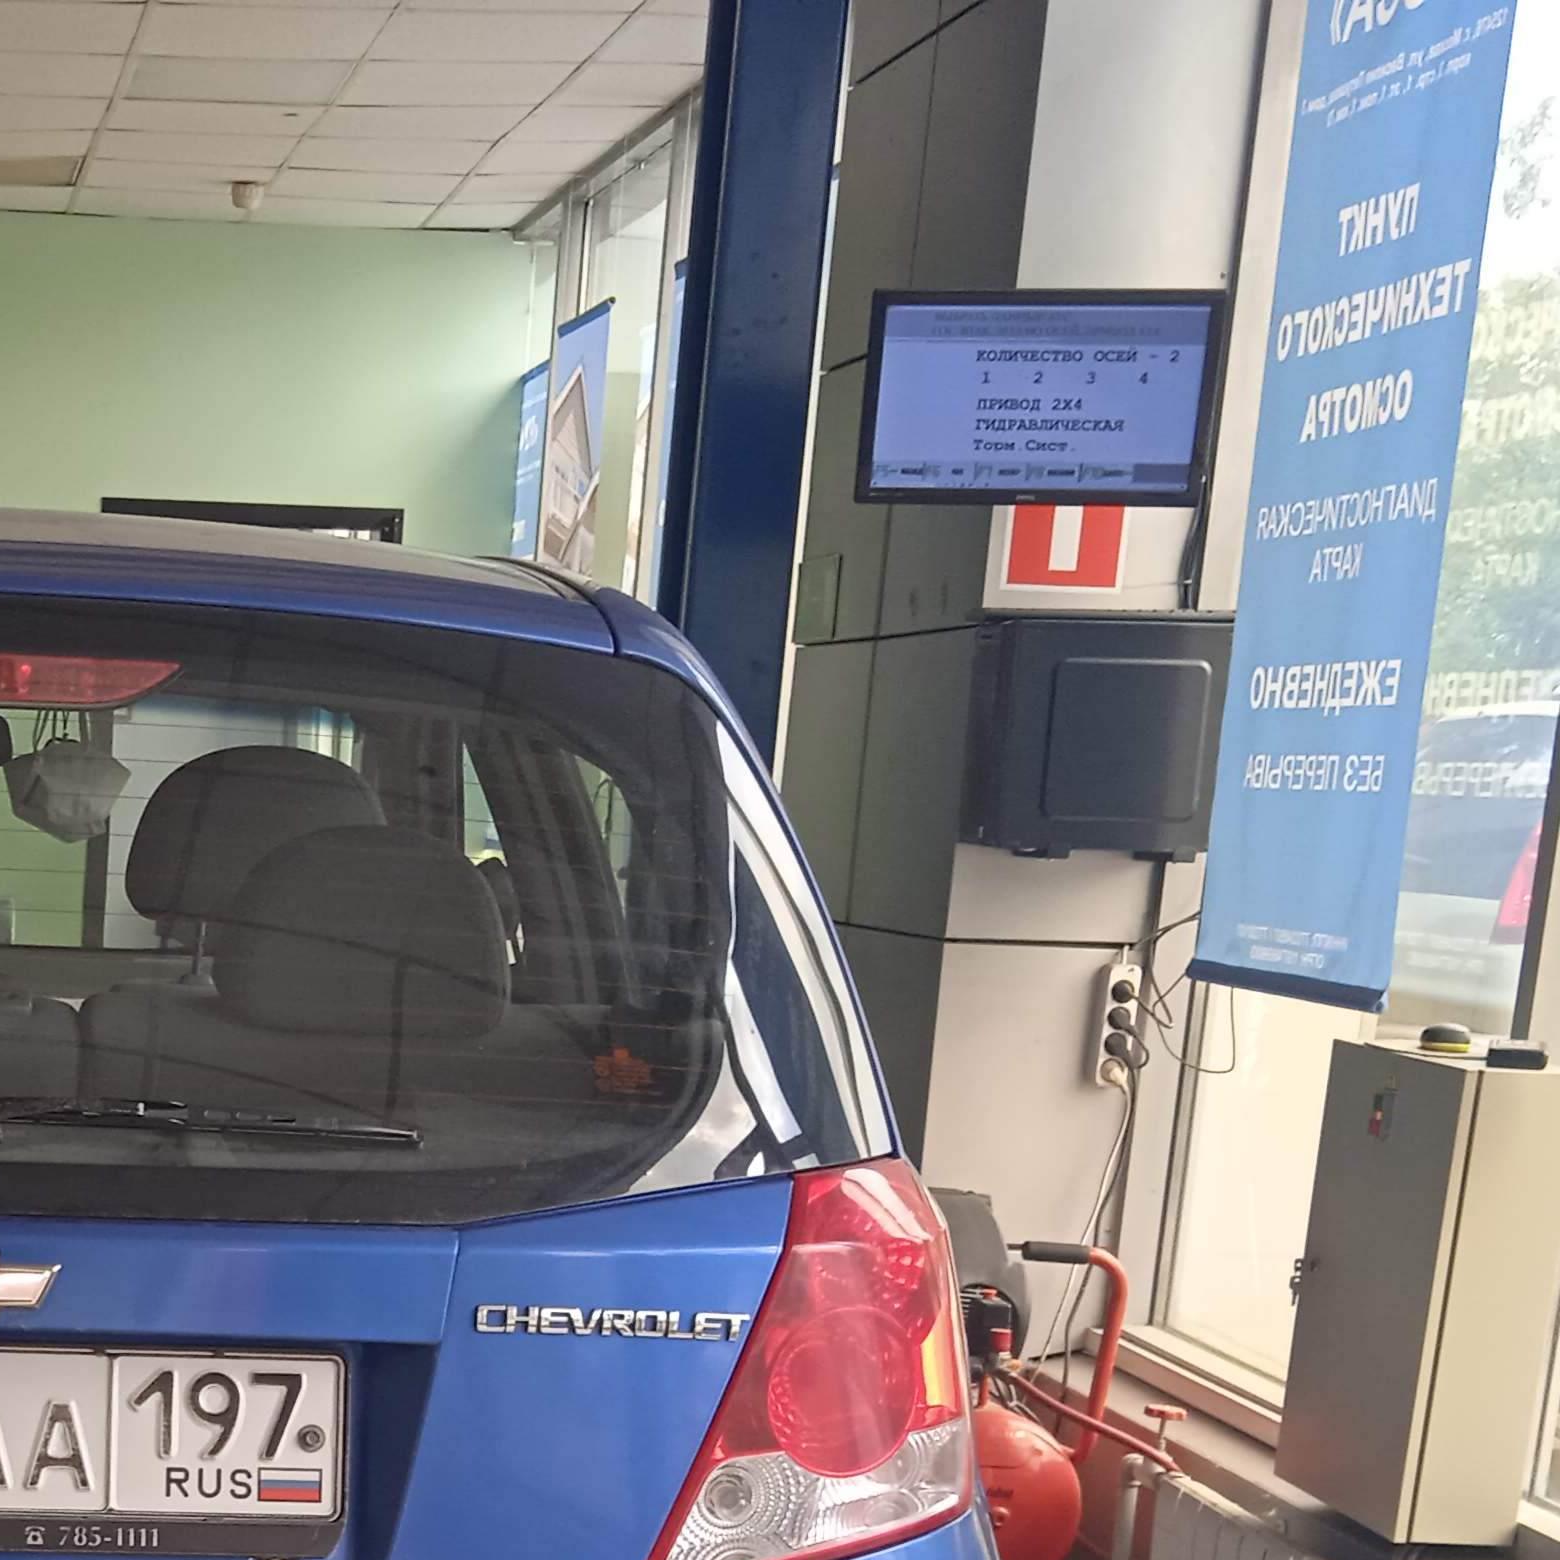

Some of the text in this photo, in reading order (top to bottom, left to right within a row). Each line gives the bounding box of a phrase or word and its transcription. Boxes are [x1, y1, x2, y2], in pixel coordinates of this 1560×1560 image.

[975, 349, 1084, 363] КОЛИЧЕСТВО
[1092, 346, 1139, 363] ОСЕЙ
[1169, 350, 1181, 363] 2
[1032, 371, 1044, 385] 2
[1084, 371, 1097, 385] 3
[1137, 371, 1149, 385] 4
[975, 398, 1042, 412] ПРИВОД
[975, 418, 1126, 432] ГИДРАВЛИЧЕСКАЯ
[474, 1303, 752, 1343] CHEVROLET
[130, 1369, 304, 1459] 197
[164, 1467, 254, 1500] RUS
[58, 1525, 160, 1548] 785-1111
